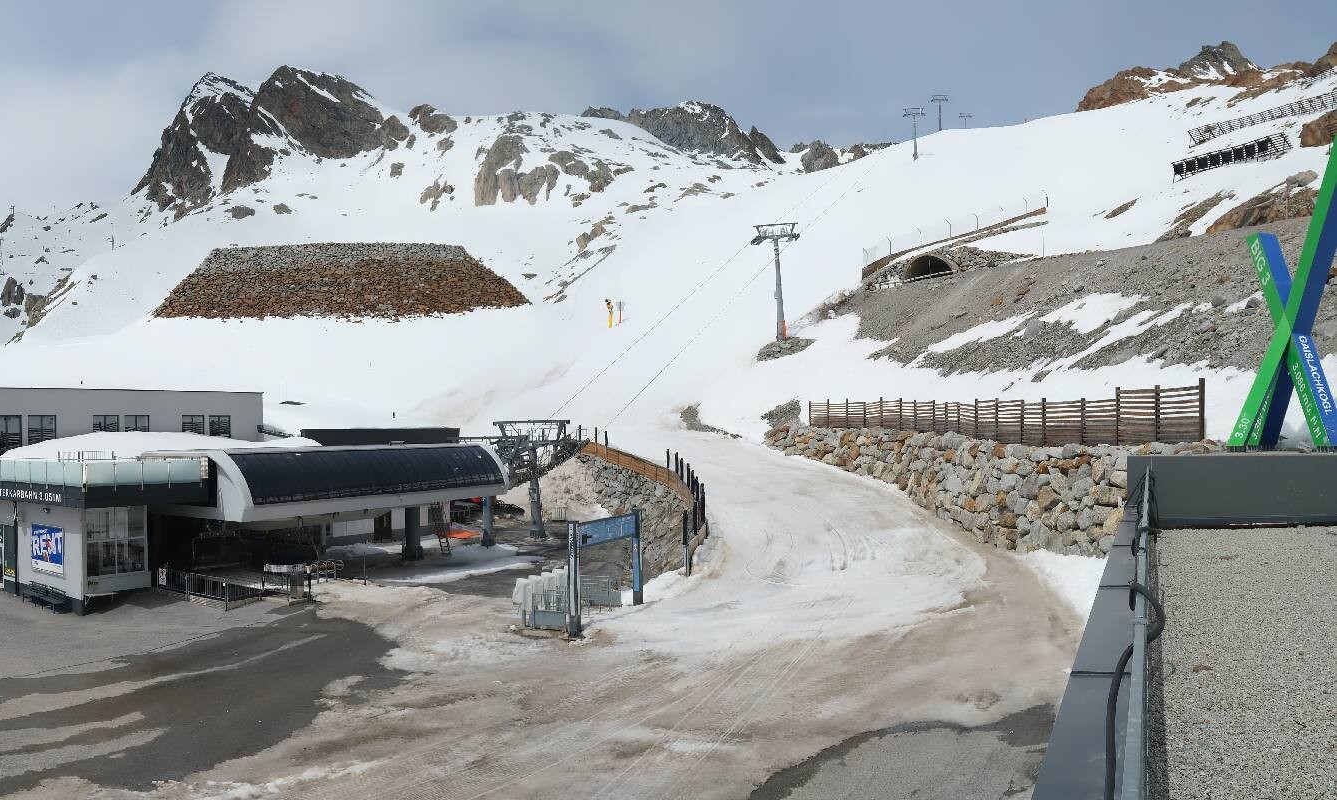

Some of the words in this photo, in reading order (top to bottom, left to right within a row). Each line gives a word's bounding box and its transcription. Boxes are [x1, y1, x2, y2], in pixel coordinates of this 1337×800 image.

[1251, 238, 1266, 272] BIG
[1262, 271, 1271, 286] 3
[1299, 335, 1333, 416] GAISLACHKOGL
[31, 532, 63, 556] RENT
